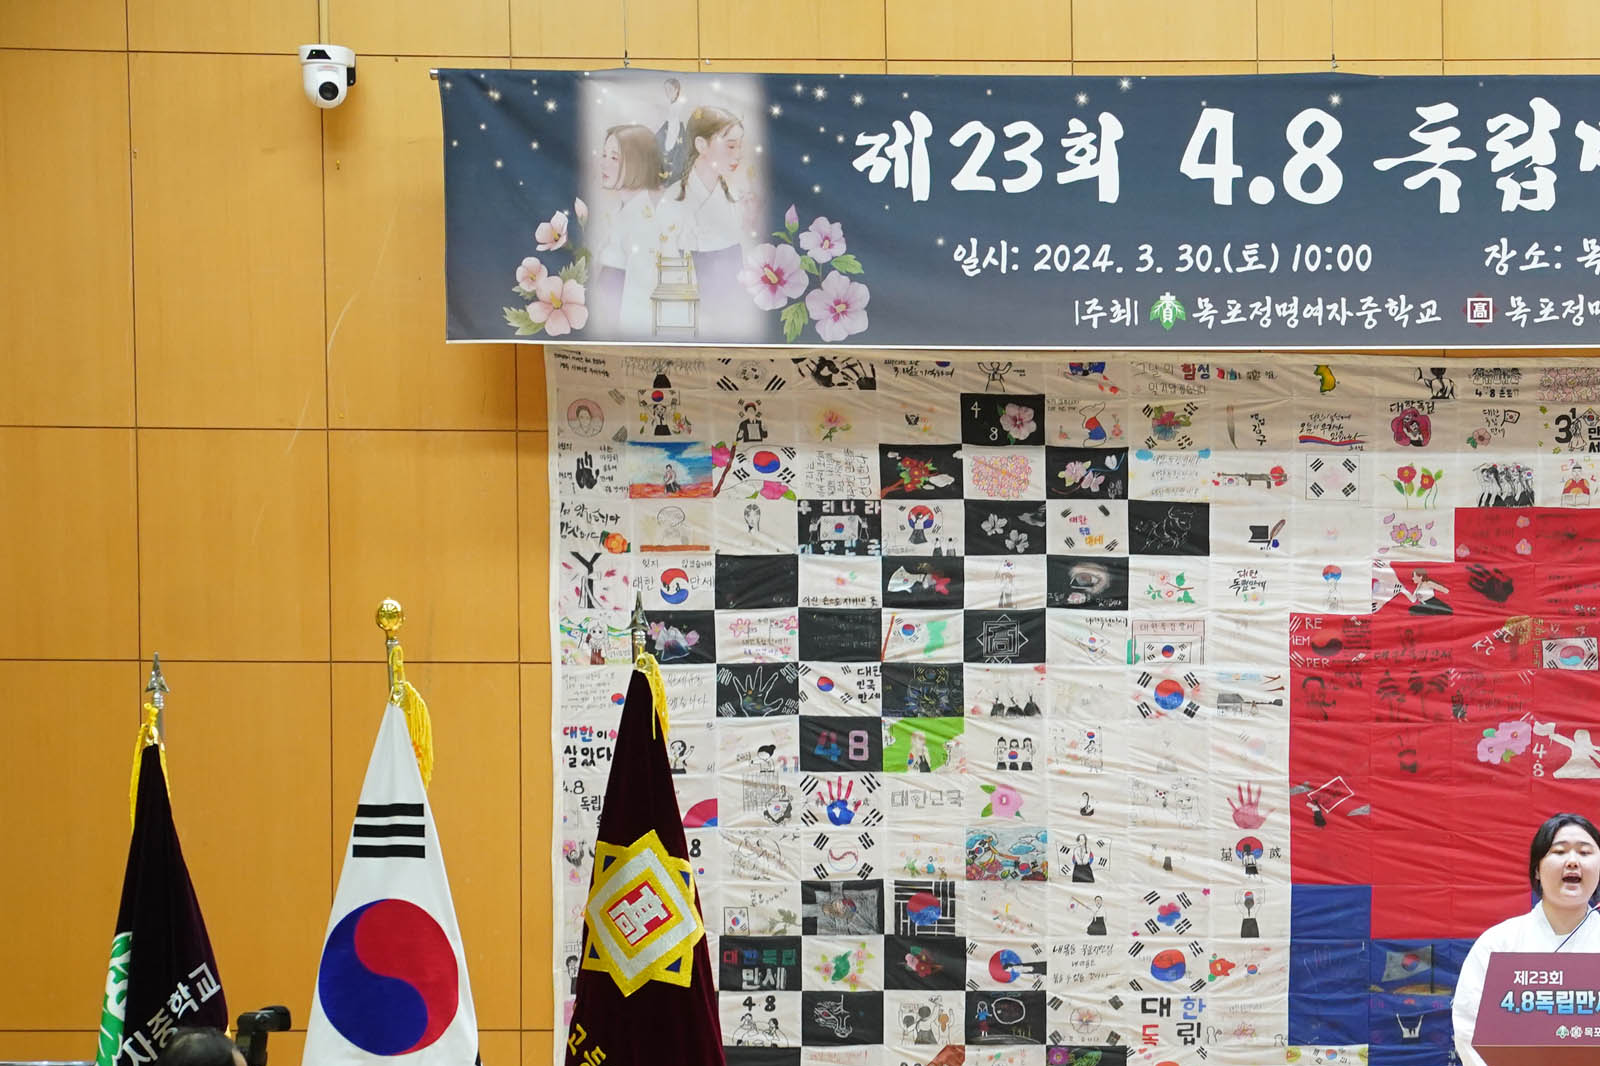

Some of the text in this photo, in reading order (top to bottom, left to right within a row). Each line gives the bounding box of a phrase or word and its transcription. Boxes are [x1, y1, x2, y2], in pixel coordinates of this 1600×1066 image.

[852, 110, 1124, 203] 제23회
[1179, 108, 1344, 206] 4.8
[953, 238, 1373, 276] 일시: 2024. 3. 30.(토) 10:00
[1484, 236, 1562, 275] 장소:
[1192, 295, 1442, 330] 목포정명여자중학교
[970, 402, 981, 419] 4
[989, 426, 998, 441] 8
[1304, 617, 1322, 630] RE
[563, 727, 607, 743] 대한이
[689, 838, 701, 858] 8
[740, 967, 787, 990] 만세
[1513, 971, 1563, 985] 제23회
